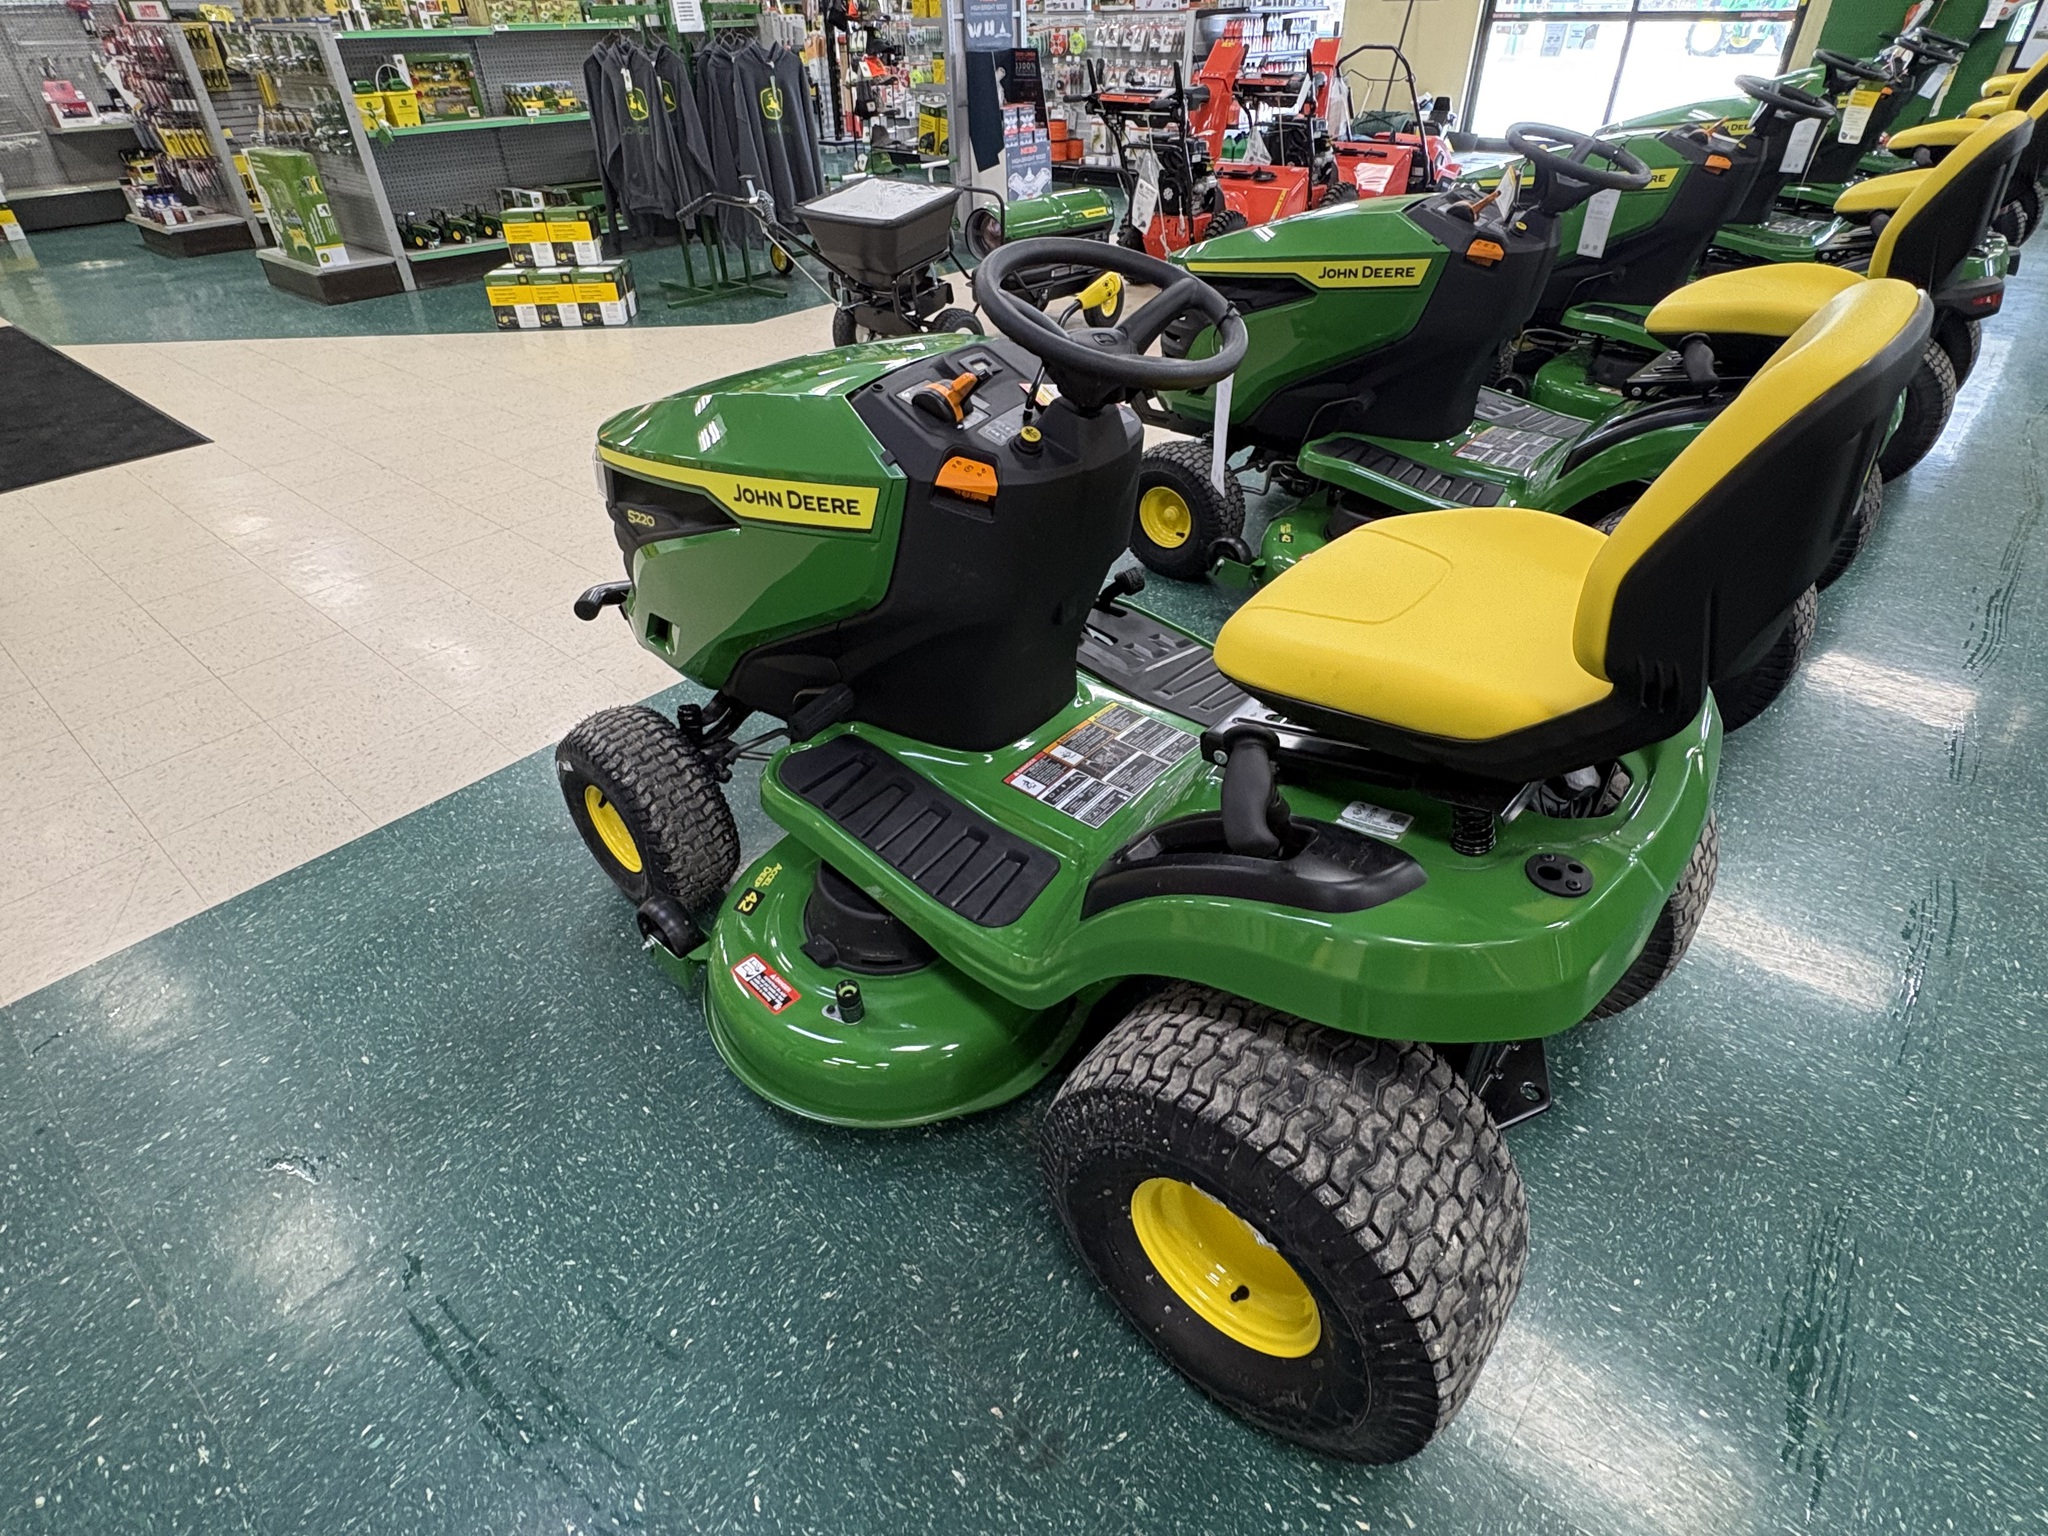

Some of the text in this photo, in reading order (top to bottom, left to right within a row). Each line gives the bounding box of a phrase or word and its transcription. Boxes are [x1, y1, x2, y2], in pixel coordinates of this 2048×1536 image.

[1318, 265, 1416, 279] JOHN DEERE
[733, 483, 861, 516] JOHN DEERE
[627, 509, 656, 527] S220
[754, 865, 773, 888] DEEP
[761, 862, 783, 887] ACCEL
[737, 891, 758, 912] 42
